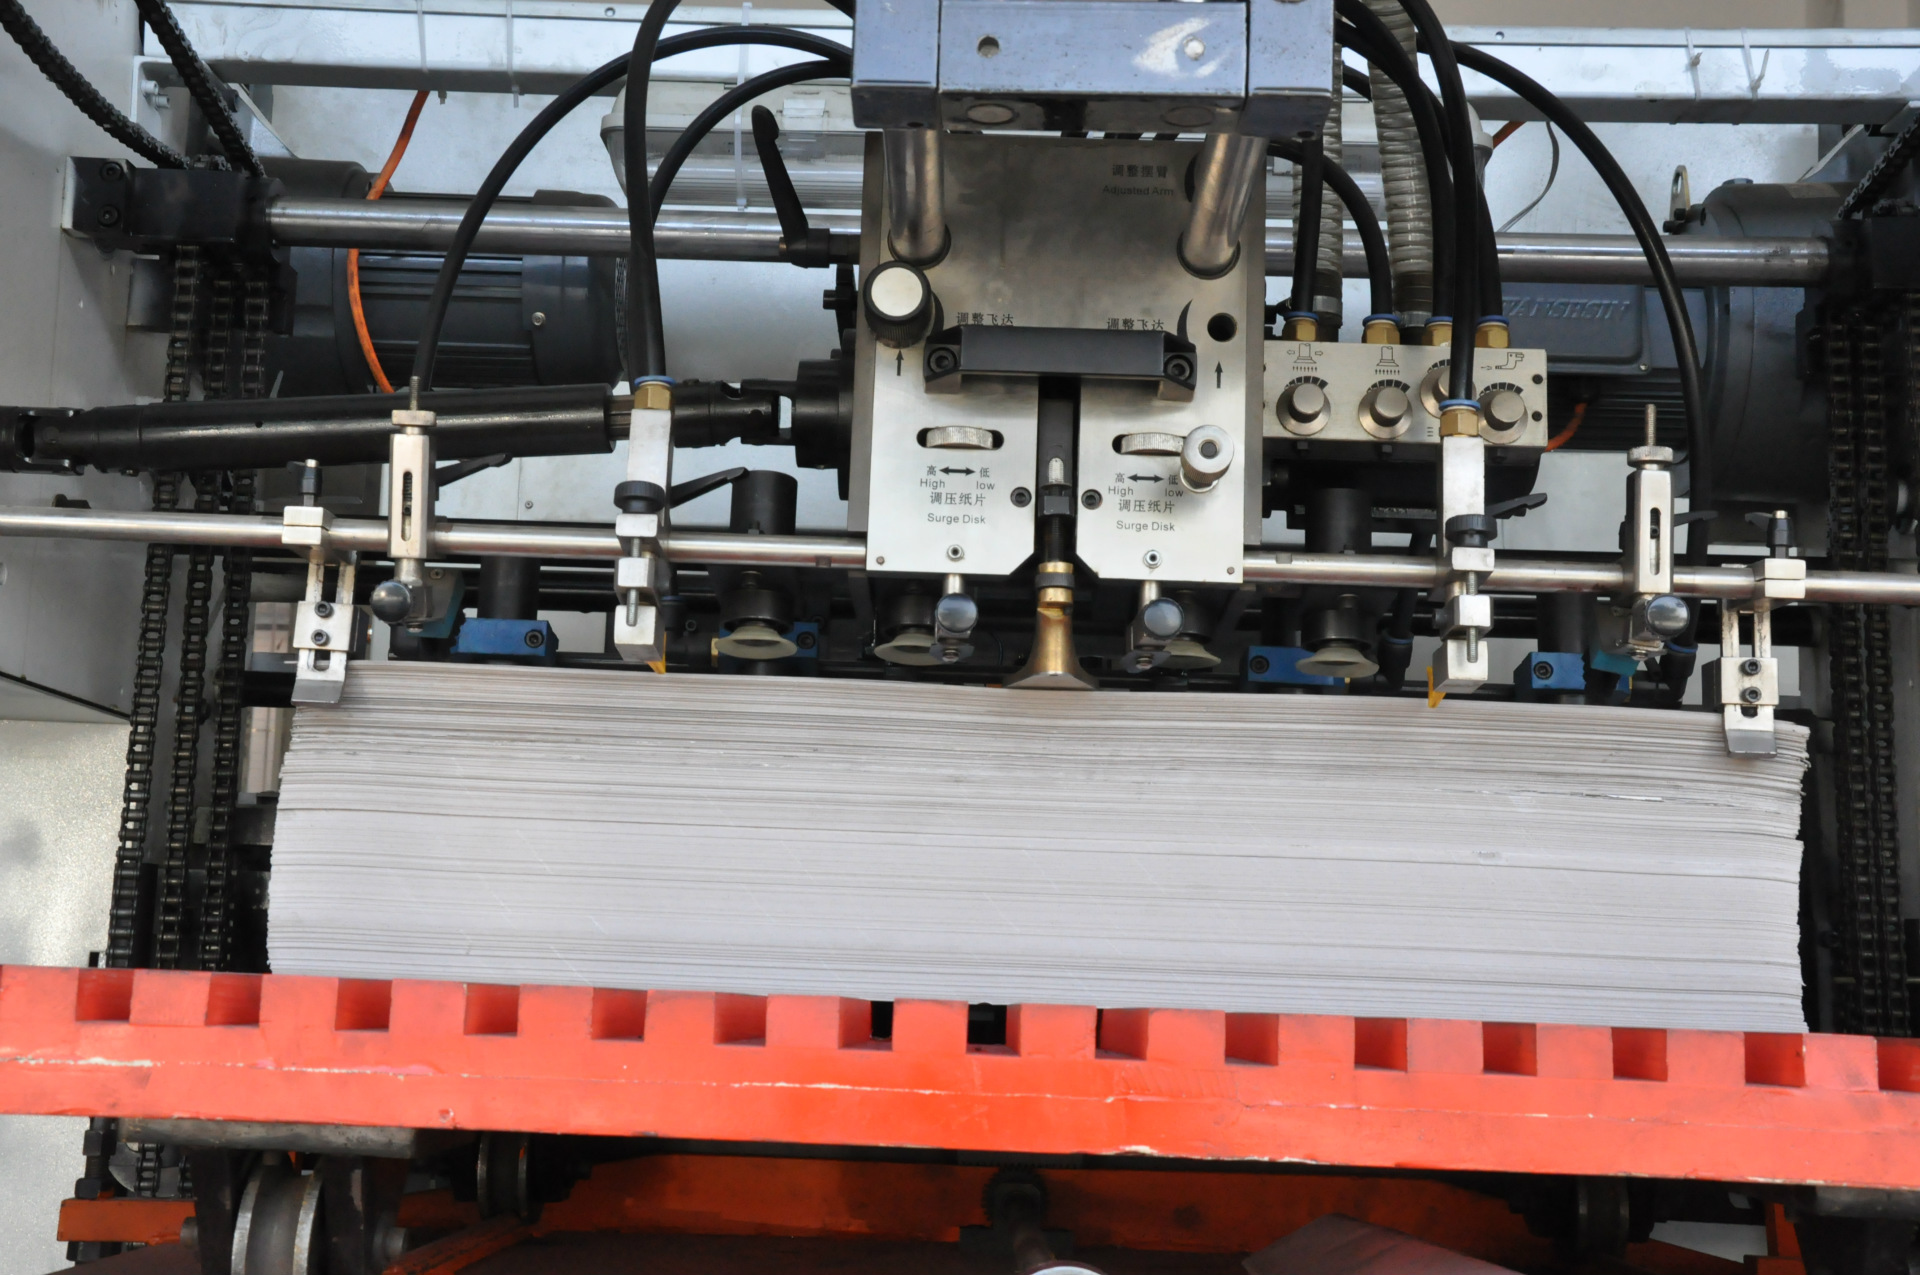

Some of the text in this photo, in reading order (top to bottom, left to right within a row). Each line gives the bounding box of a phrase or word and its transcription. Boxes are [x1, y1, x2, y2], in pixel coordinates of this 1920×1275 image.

[1102, 185, 1174, 196] Adjusted Arm
[926, 465, 990, 478] 高 低
[919, 478, 995, 490] High low
[1115, 472, 1179, 486] 高 低
[1108, 486, 1184, 497] High low
[930, 491, 987, 507] 调压纸片
[1118, 499, 1175, 514] 调压纸片
[927, 512, 986, 525] Surge Disk
[1116, 520, 1175, 532] Surge Disk
